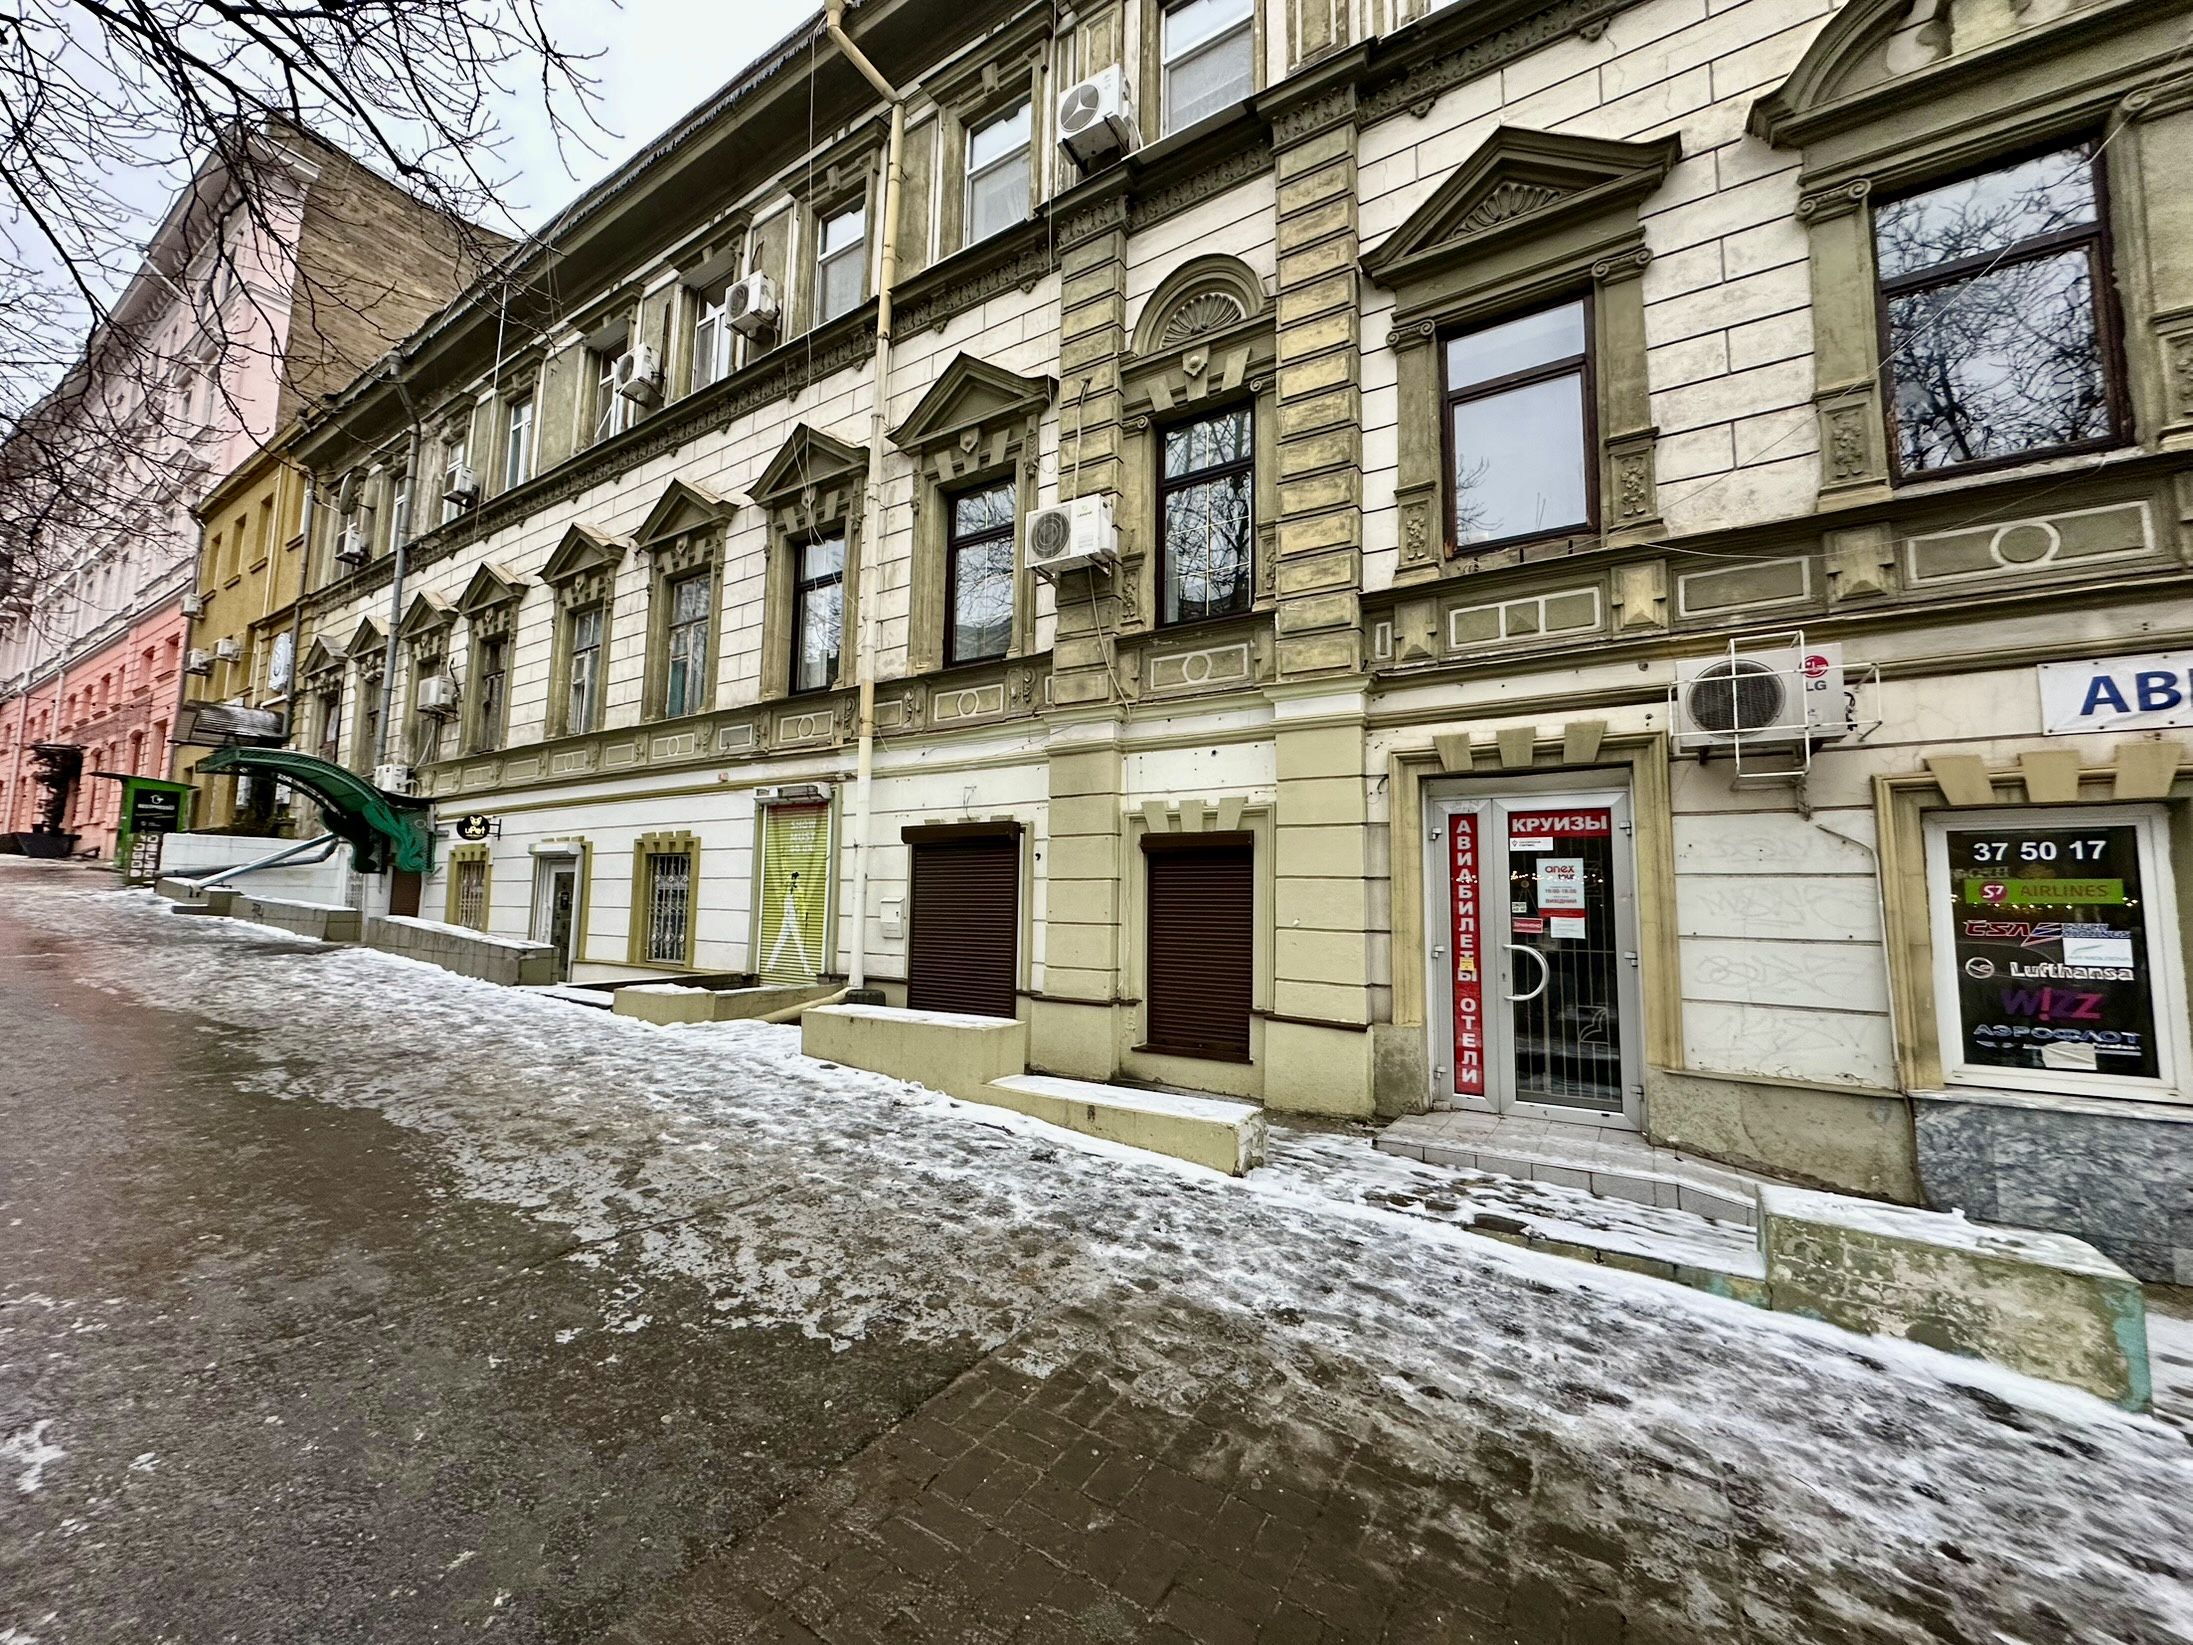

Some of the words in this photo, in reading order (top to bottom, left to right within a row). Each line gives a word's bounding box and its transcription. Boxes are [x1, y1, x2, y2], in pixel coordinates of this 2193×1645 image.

[1805, 680, 1827, 691] LG
[2080, 668, 2193, 716] АВ
[1512, 815, 1607, 832] КРУИЗЫ
[1973, 843, 2008, 861] 37
[2020, 842, 2057, 861] 50
[2069, 841, 2106, 860] 17
[1545, 865, 1574, 873] anex
[1982, 885, 2004, 898] S7
[2009, 961, 2135, 981] Lufthansa
[1460, 997, 1479, 1084] ОТЕЛИ
[1973, 1023, 2142, 1044] АЭРОФЛОТ
